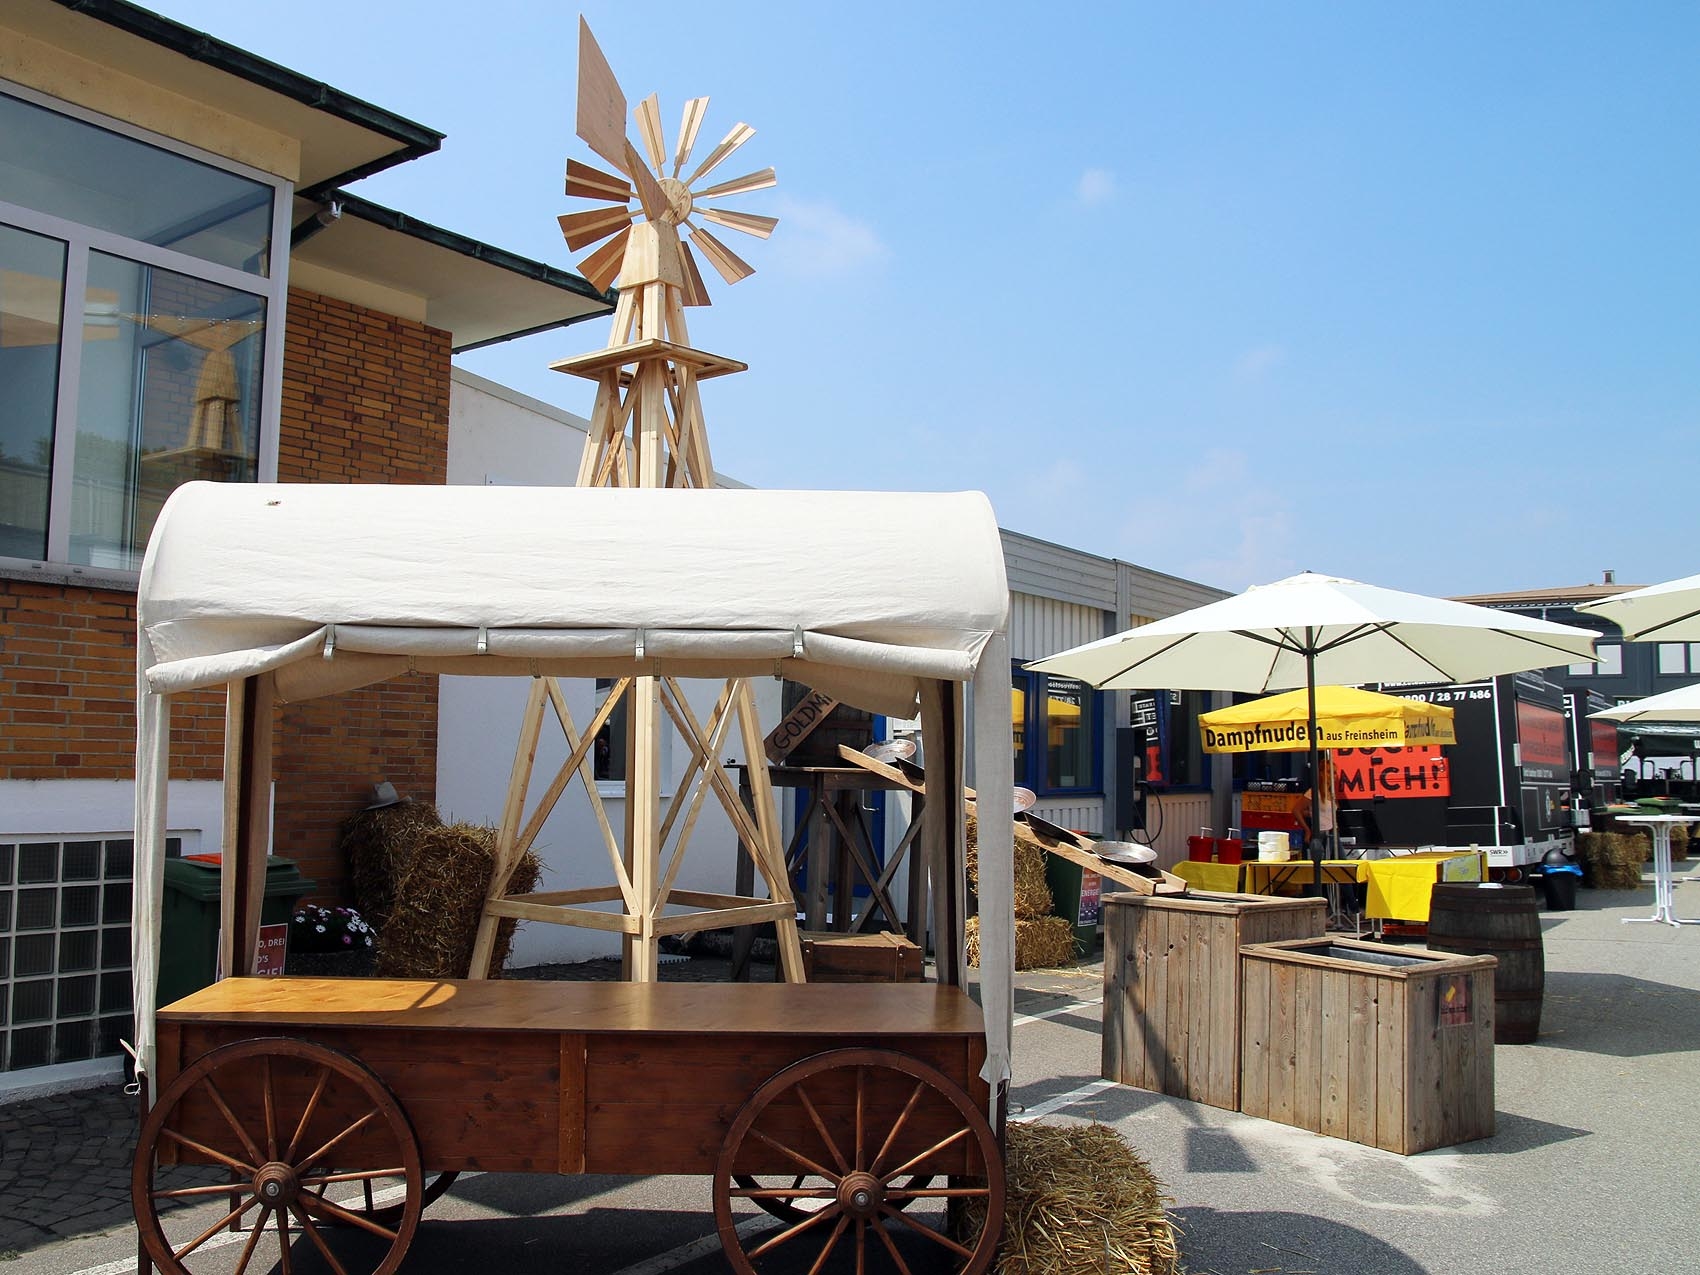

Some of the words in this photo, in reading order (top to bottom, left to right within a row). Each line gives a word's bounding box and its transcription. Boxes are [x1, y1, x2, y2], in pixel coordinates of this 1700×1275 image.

[1437, 692, 1451, 702] 28
[1454, 691, 1466, 701] 77
[1469, 690, 1491, 699] 486
[1326, 733, 1342, 741] aus
[1345, 729, 1398, 740] Freinsheim
[1338, 765, 1440, 793] MICH!
[268, 938, 285, 947] DREI
